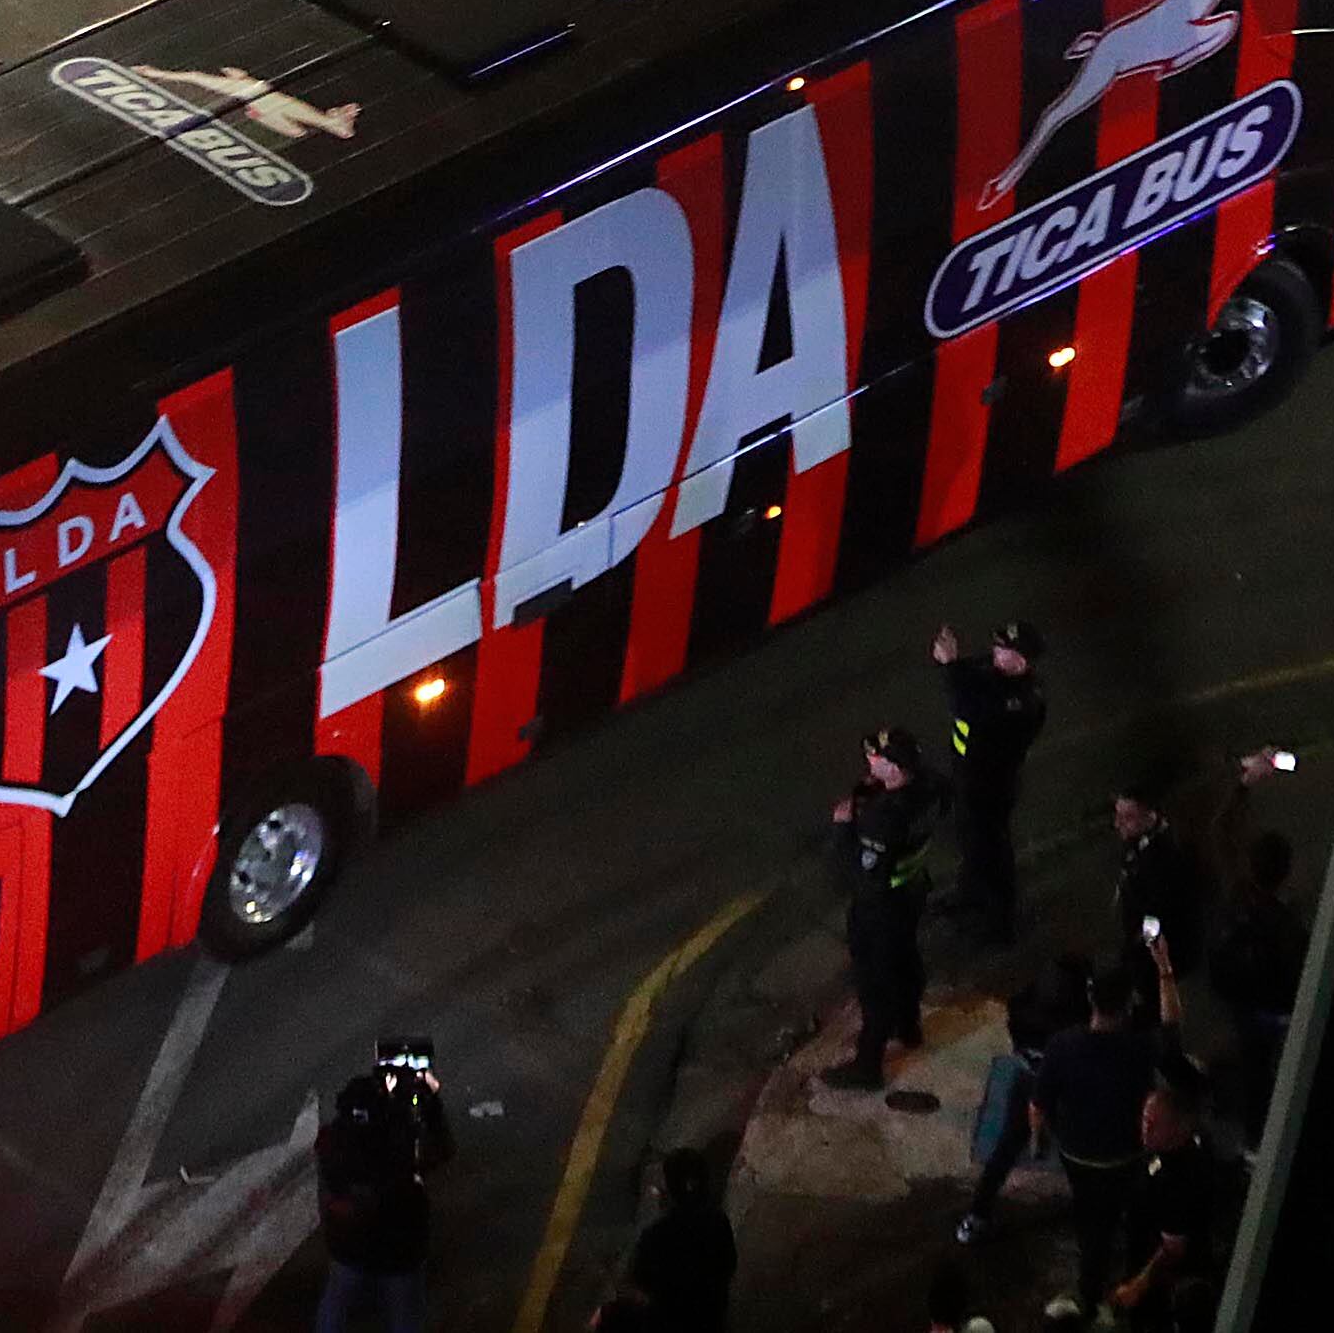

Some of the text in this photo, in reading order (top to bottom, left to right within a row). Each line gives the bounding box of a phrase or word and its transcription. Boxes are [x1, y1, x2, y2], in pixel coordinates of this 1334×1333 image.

[73, 68, 295, 188] TICA BUS
[961, 105, 1273, 312] TICA BUS
[319, 104, 853, 719] LDA
[4, 492, 146, 594] LDA
